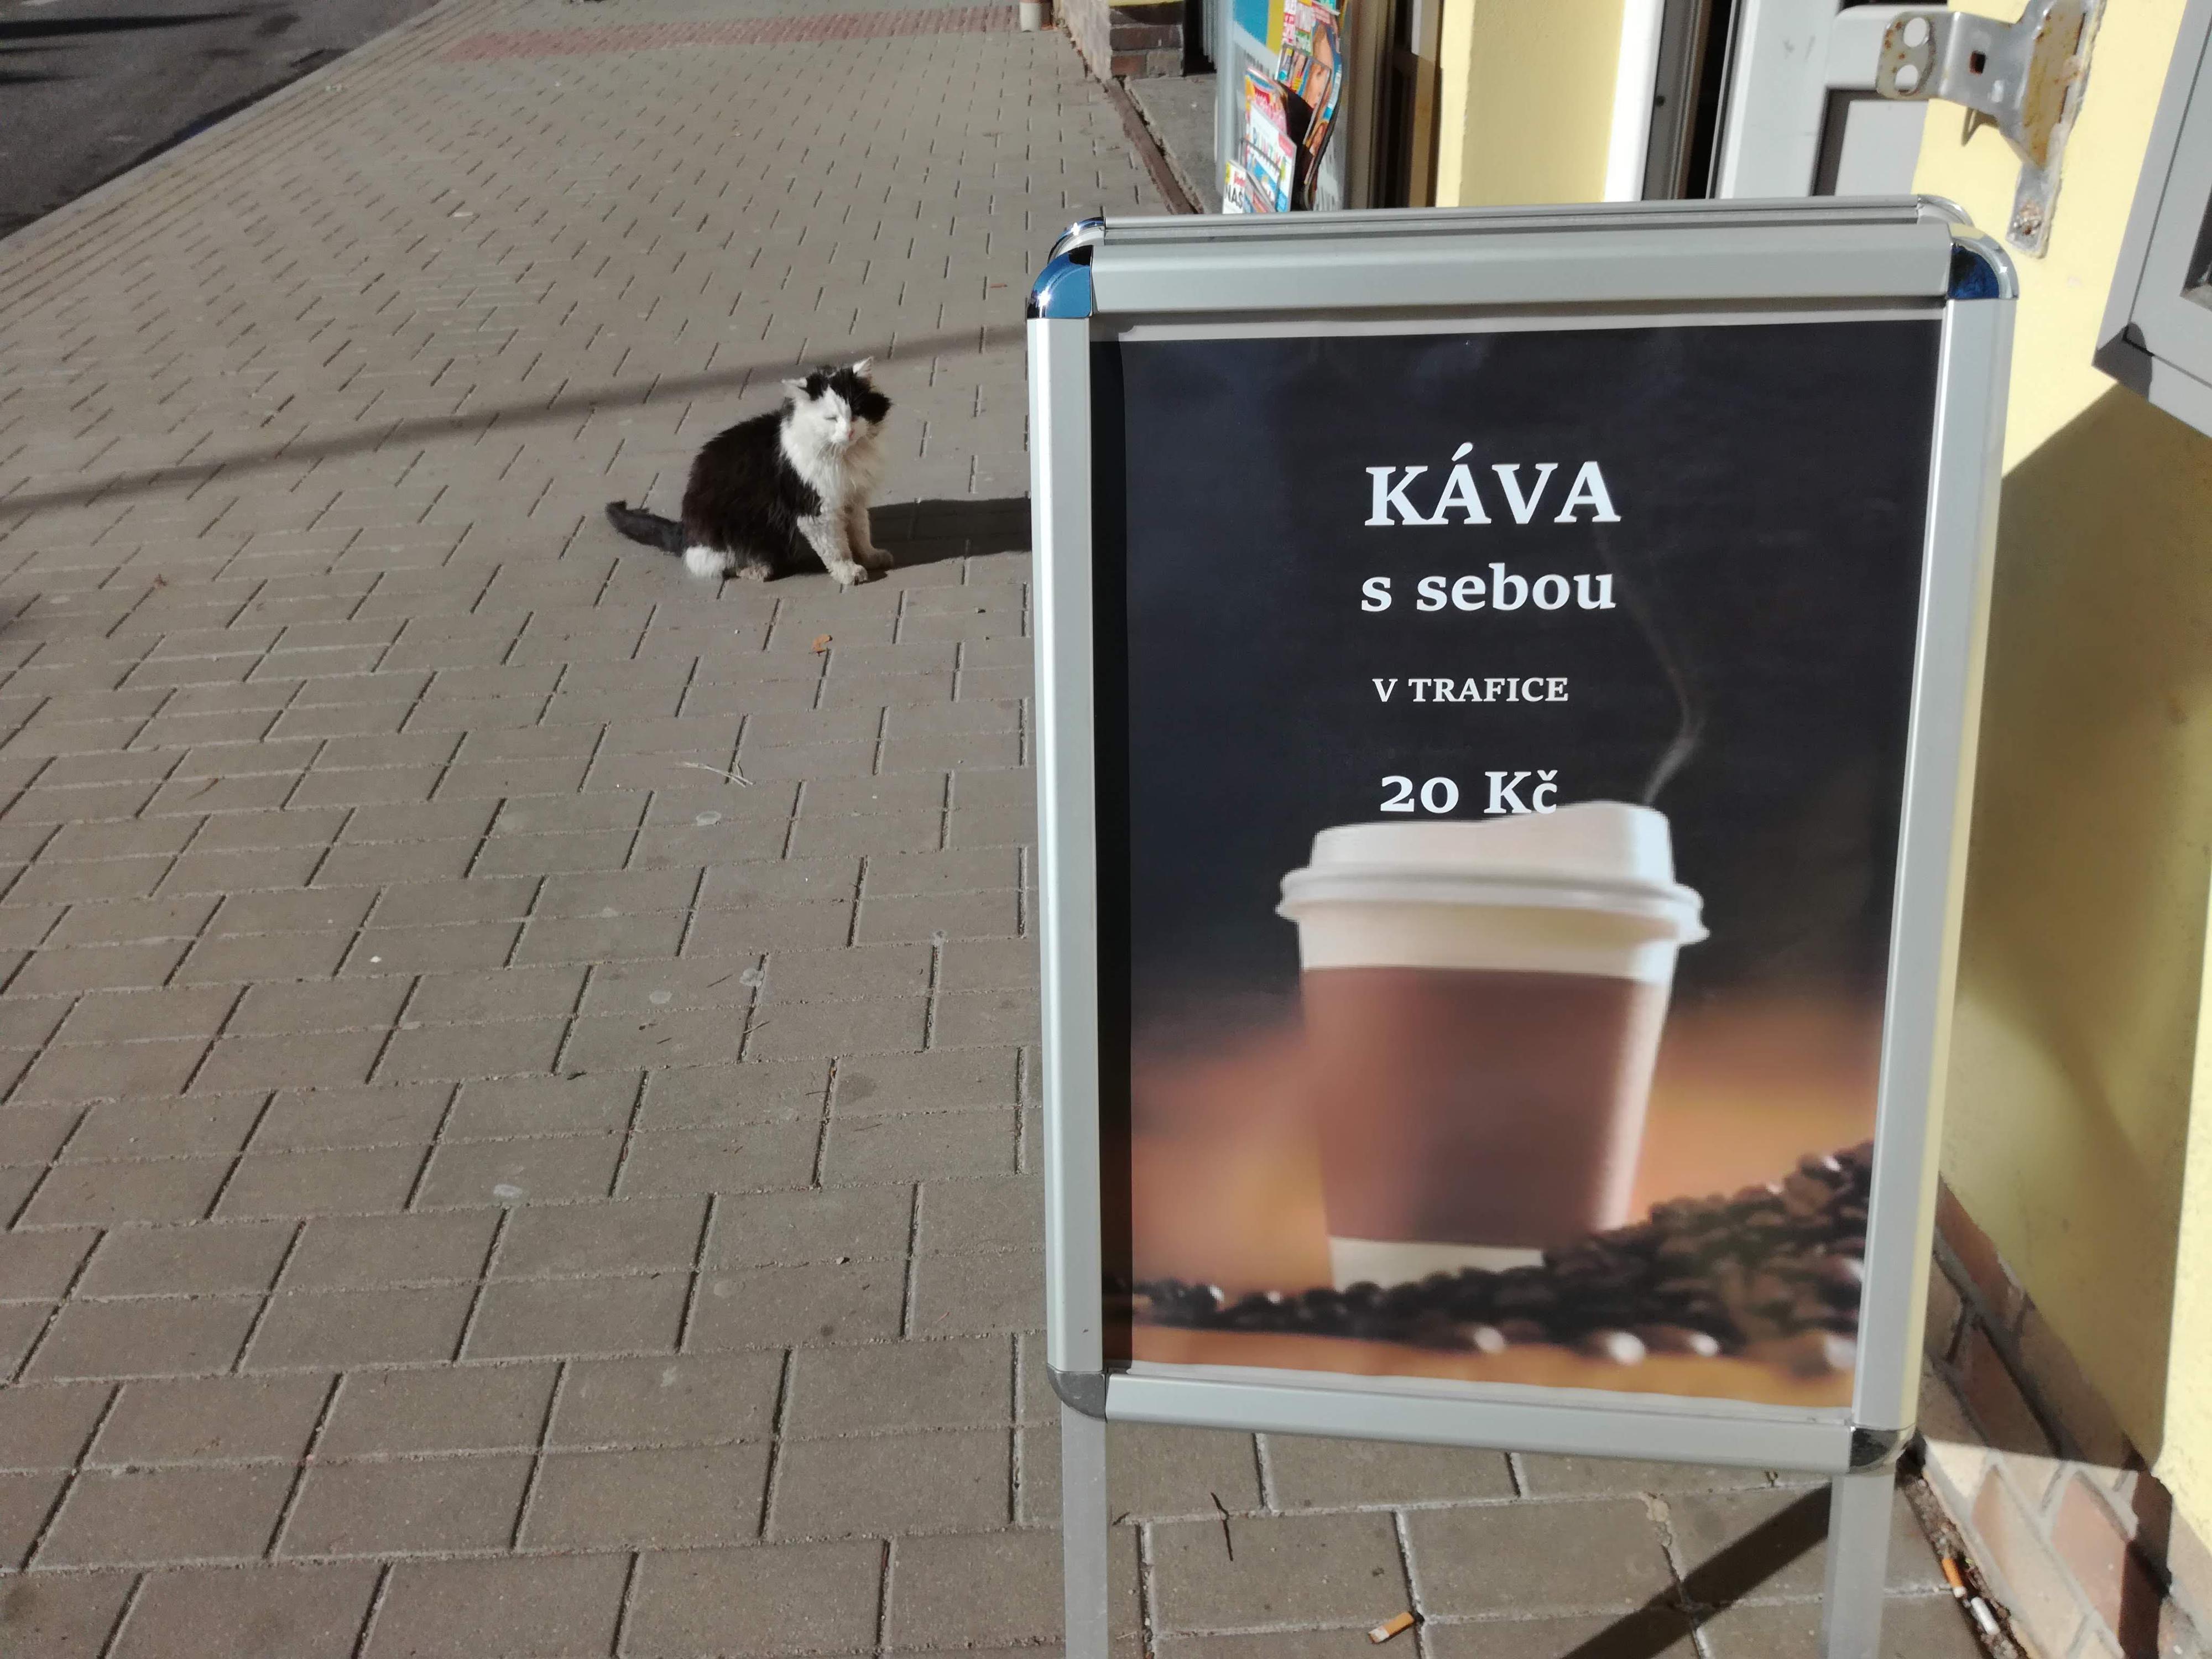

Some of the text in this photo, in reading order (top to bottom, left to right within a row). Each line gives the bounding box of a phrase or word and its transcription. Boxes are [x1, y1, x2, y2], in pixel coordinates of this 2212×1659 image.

[1364, 442, 1621, 526] KÁVA
[1361, 563, 1616, 612] s sebou
[1372, 677, 1568, 702] V TRAFICE
[1380, 770, 1558, 814] 20 Kč
